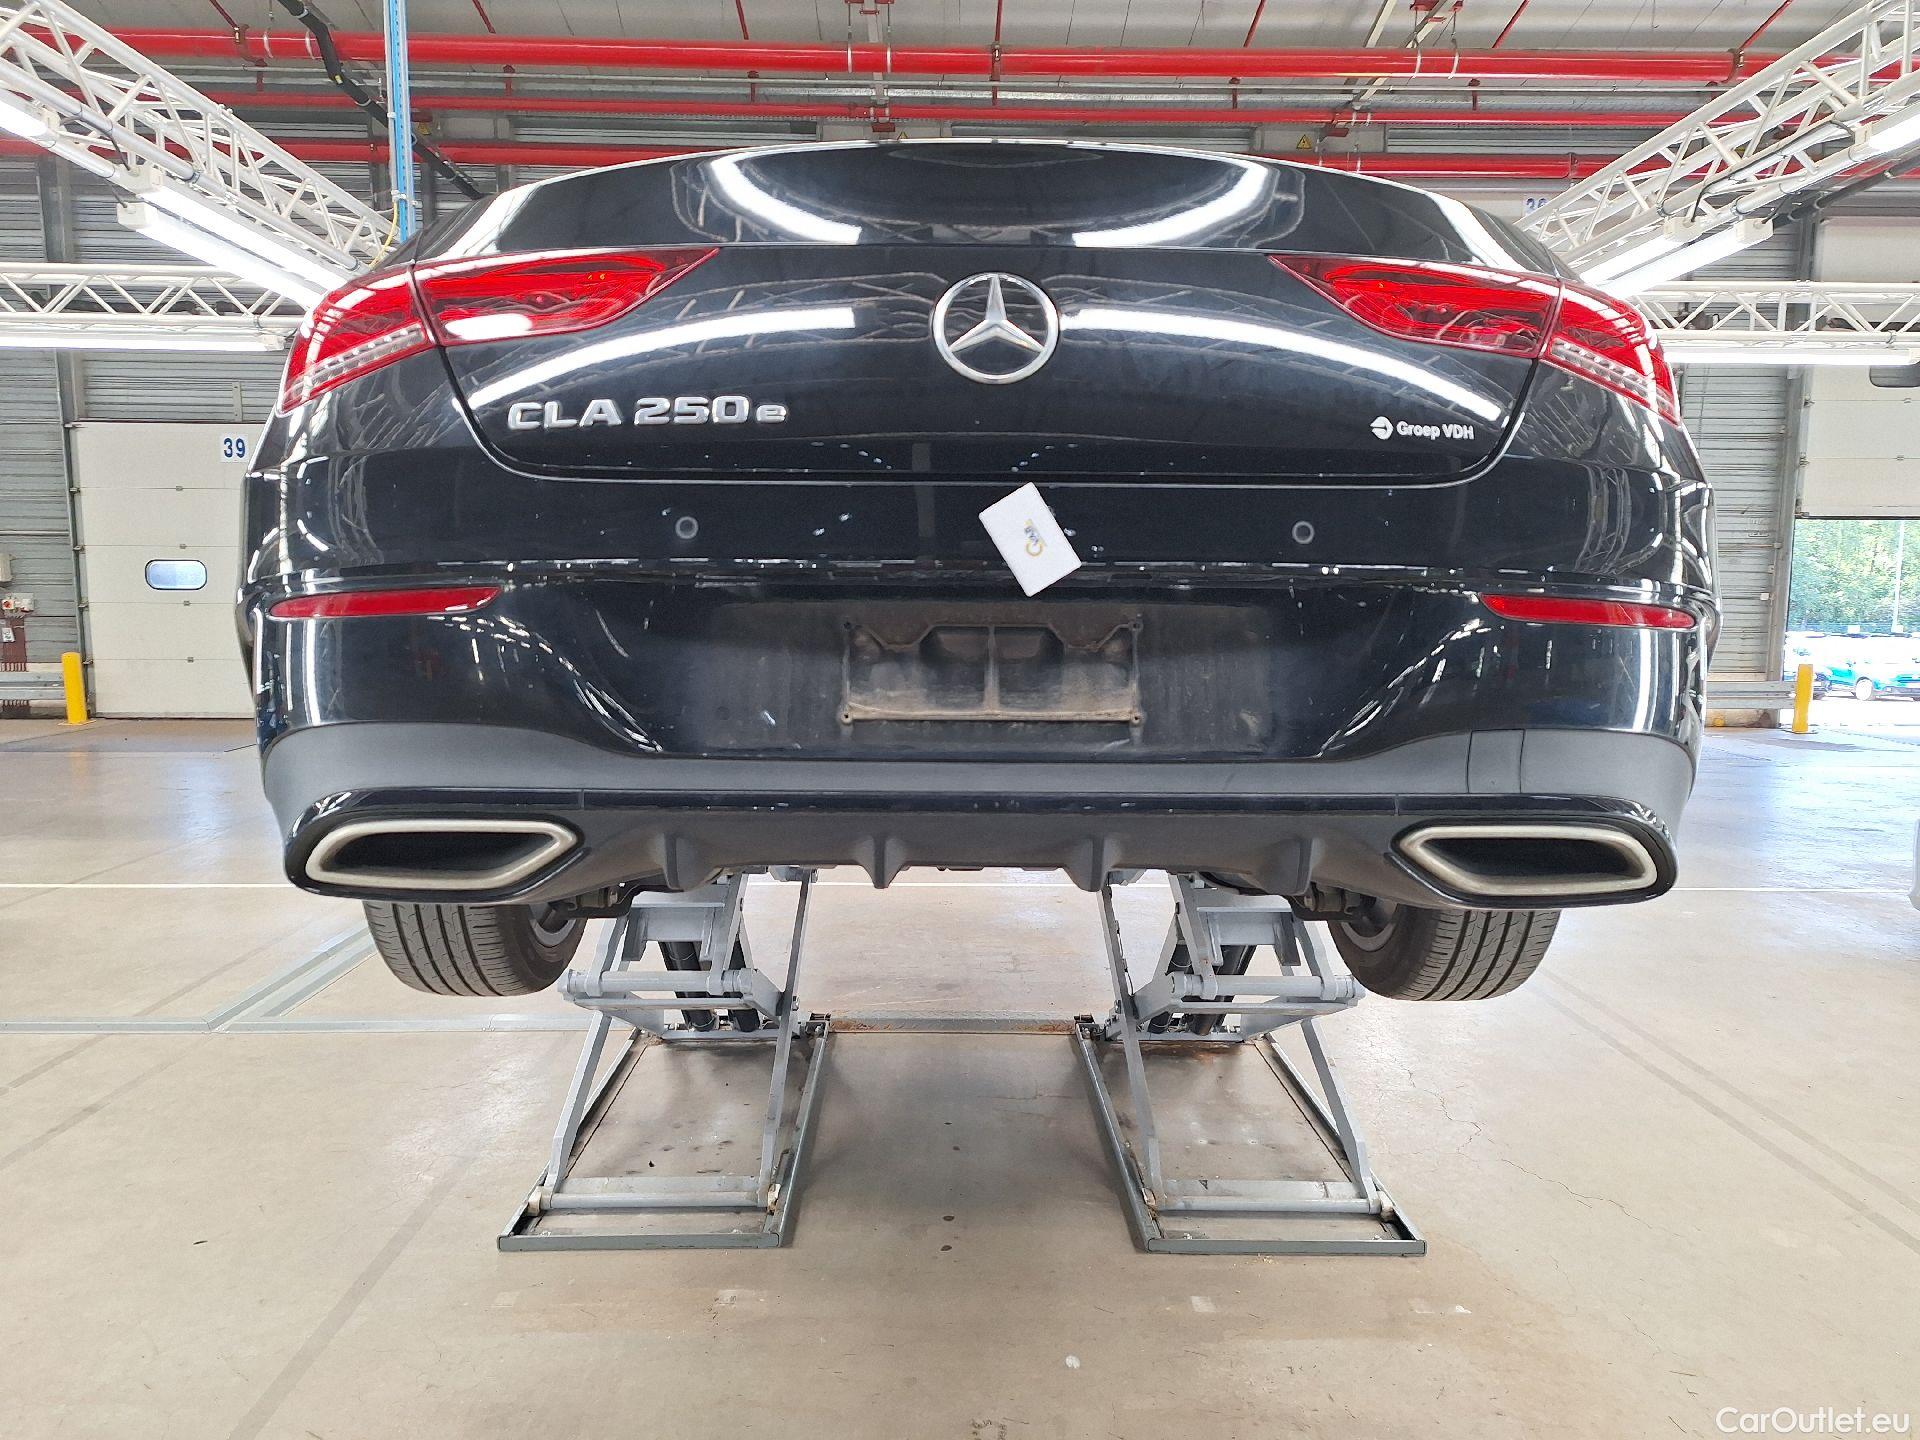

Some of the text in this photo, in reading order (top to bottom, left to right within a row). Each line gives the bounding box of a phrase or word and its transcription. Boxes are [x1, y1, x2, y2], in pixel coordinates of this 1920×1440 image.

[507, 399, 622, 431] CLA
[1396, 420, 1475, 440] Groep VDH
[223, 437, 246, 458] 39
